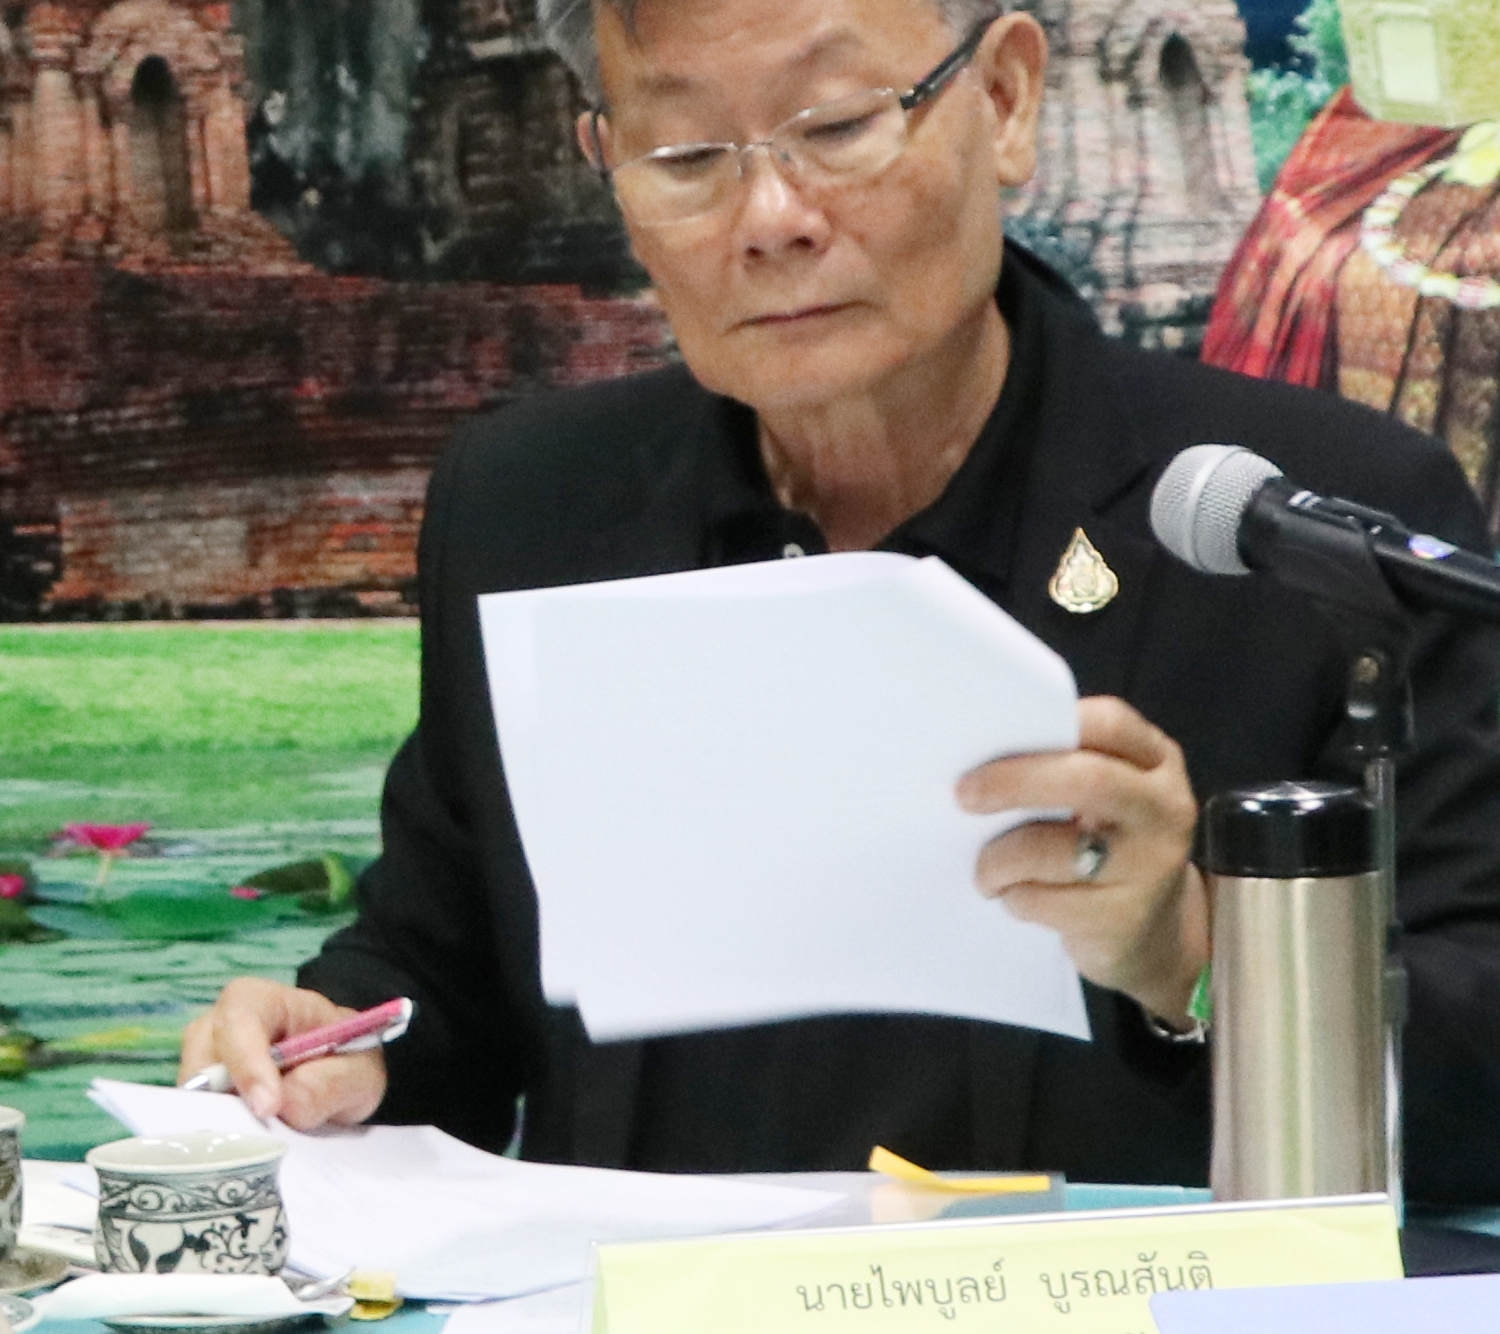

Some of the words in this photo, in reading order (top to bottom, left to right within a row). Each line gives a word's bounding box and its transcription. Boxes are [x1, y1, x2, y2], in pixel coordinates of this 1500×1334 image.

[796, 1258, 1008, 1321] นายไพบูลย์
[1039, 1250, 1214, 1315] บูรณสันติ
